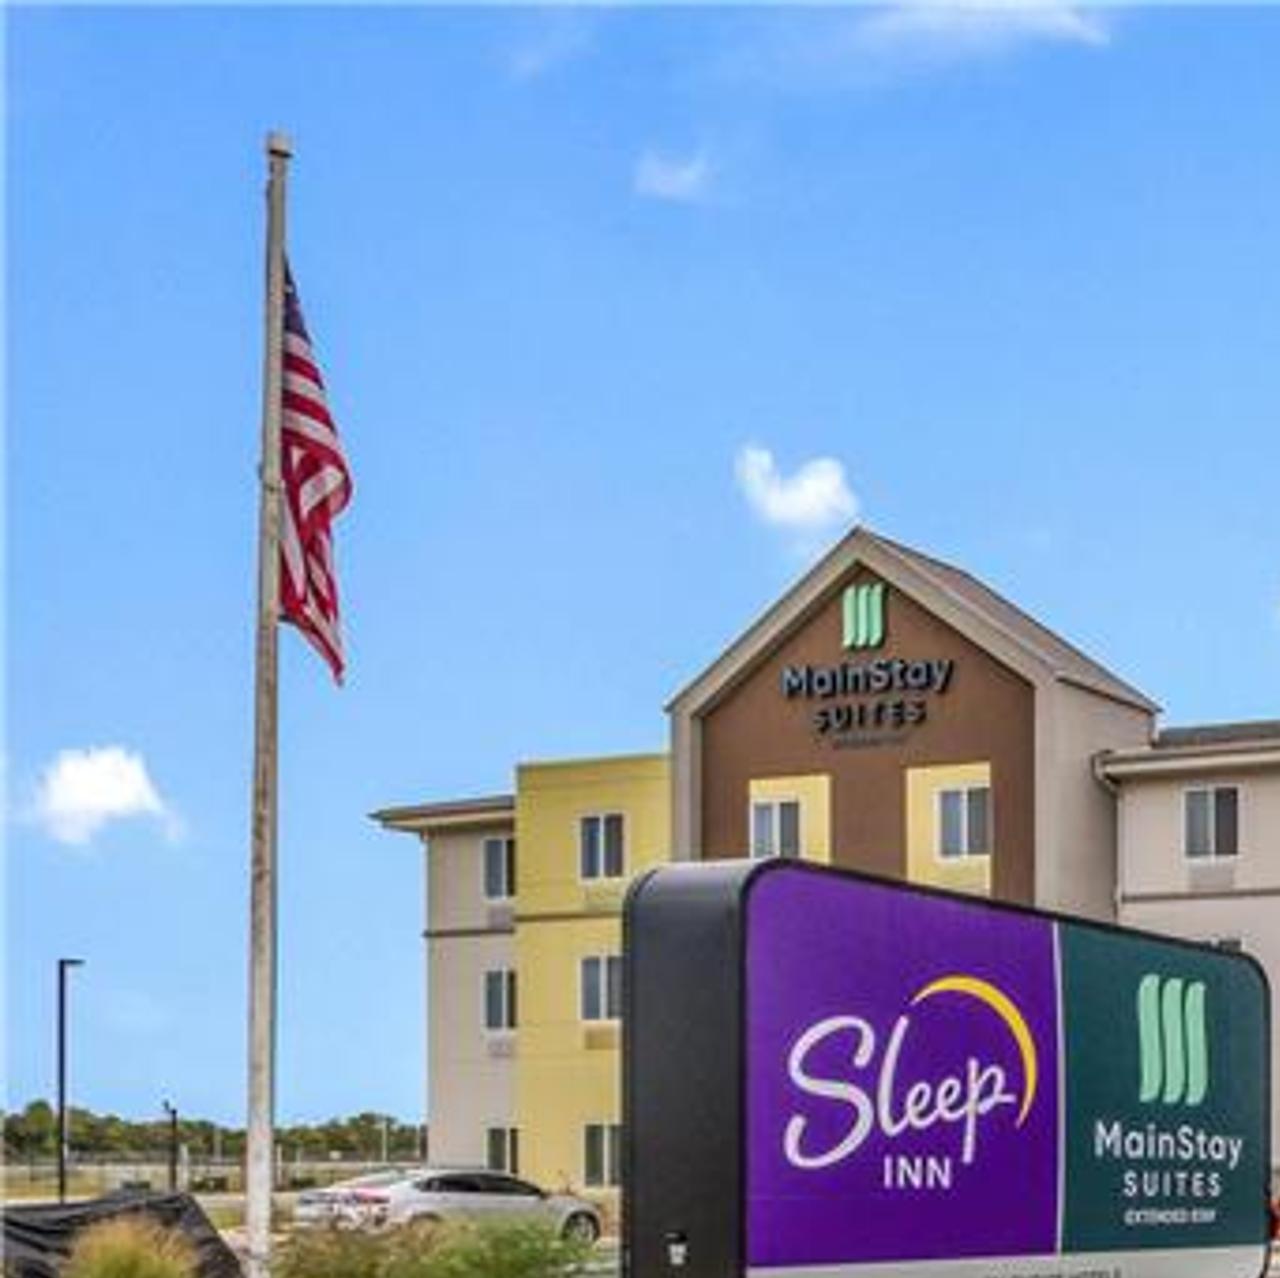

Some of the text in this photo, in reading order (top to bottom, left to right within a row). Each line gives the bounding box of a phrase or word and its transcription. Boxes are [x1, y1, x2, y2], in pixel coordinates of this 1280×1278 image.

[781, 659, 953, 699] MainStay
[813, 700, 927, 734] SUITES
[783, 1014, 1015, 1169] Sleep
[1093, 1119, 1244, 1171] MainStay
[883, 1155, 952, 1189] INN
[1123, 1169, 1222, 1198] SUITES
